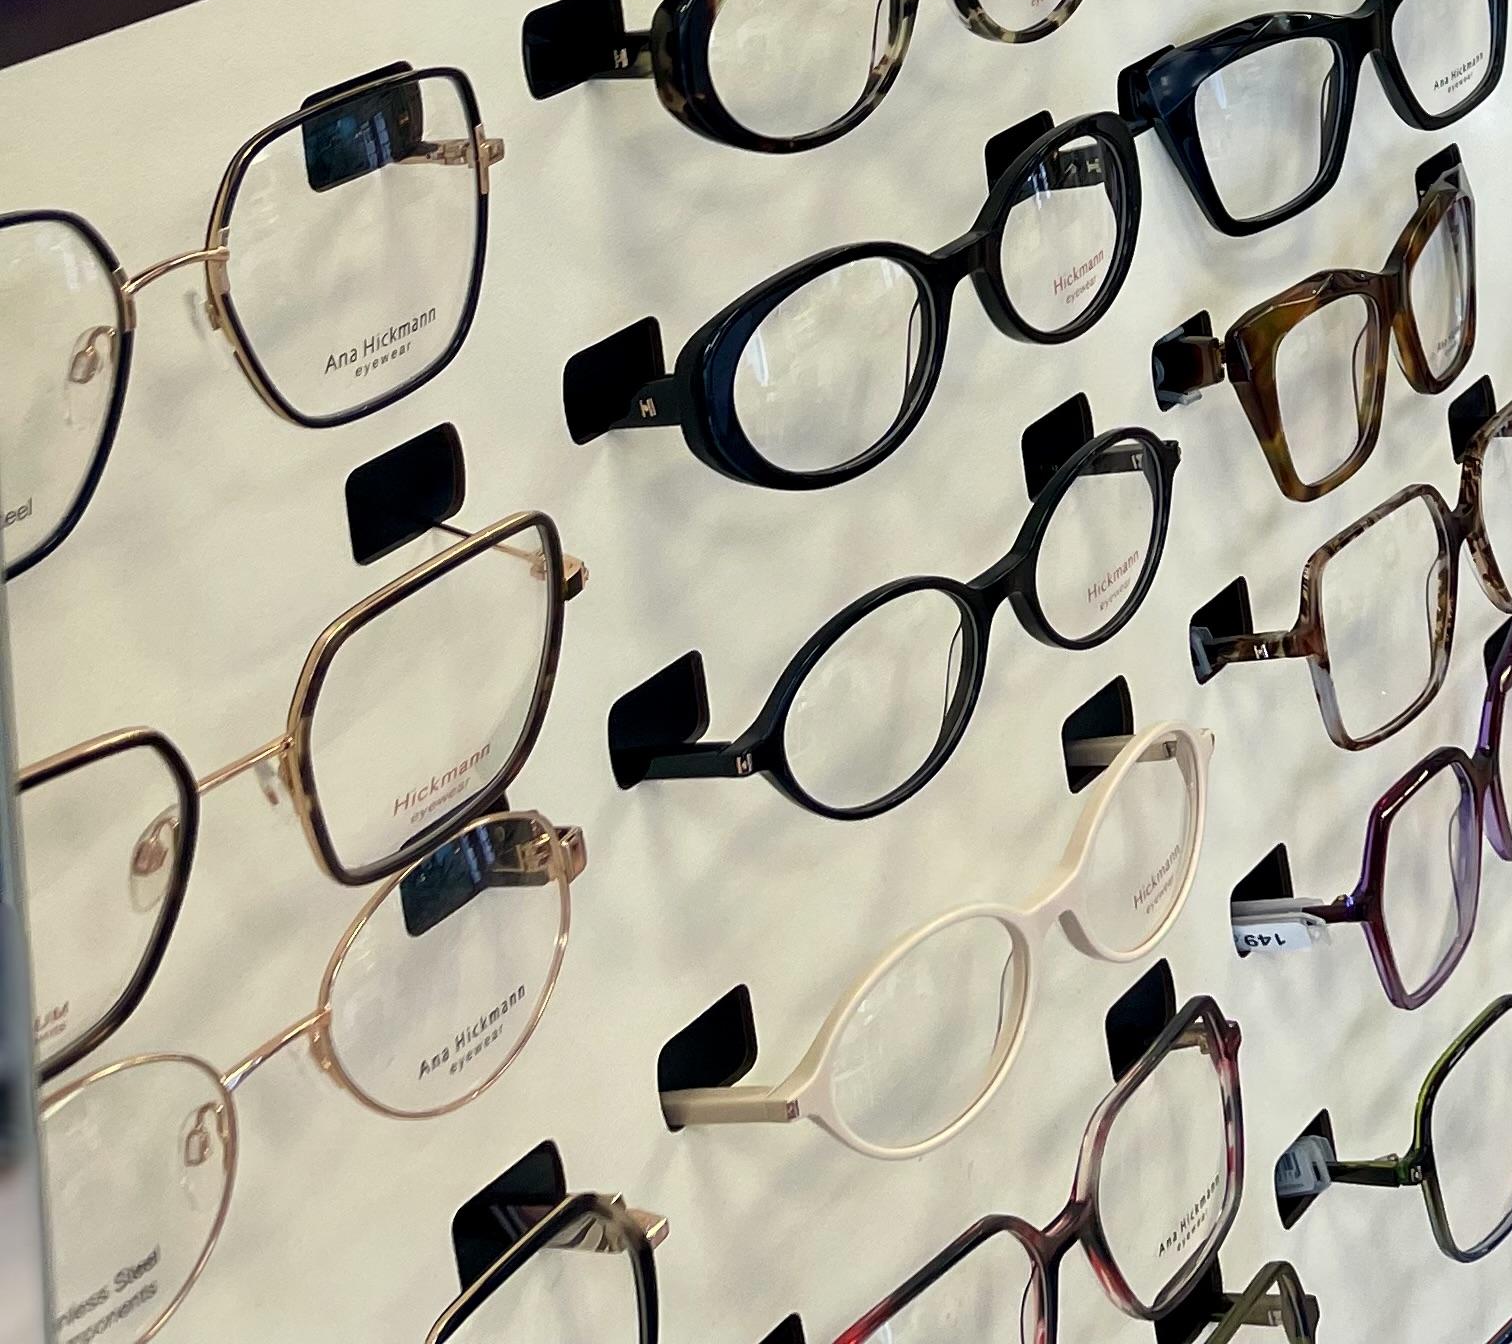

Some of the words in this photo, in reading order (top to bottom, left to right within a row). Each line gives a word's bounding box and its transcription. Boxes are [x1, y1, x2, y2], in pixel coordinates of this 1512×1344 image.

[1053, 249, 1105, 296] Hickmann
[324, 346, 358, 375] Ana
[363, 306, 437, 359] Hickmann
[355, 341, 412, 378] eyewear
[5, 496, 33, 526] eel
[1086, 550, 1140, 603] Hickmann
[392, 743, 491, 816] Hickmann
[1132, 844, 1181, 911] Hickmann
[418, 1046, 450, 1080] Ana
[455, 984, 526, 1049] Hickmann
[448, 1022, 504, 1075] eyewear
[1158, 1230, 1178, 1257] Ana
[1180, 1174, 1220, 1234] Hickmann
